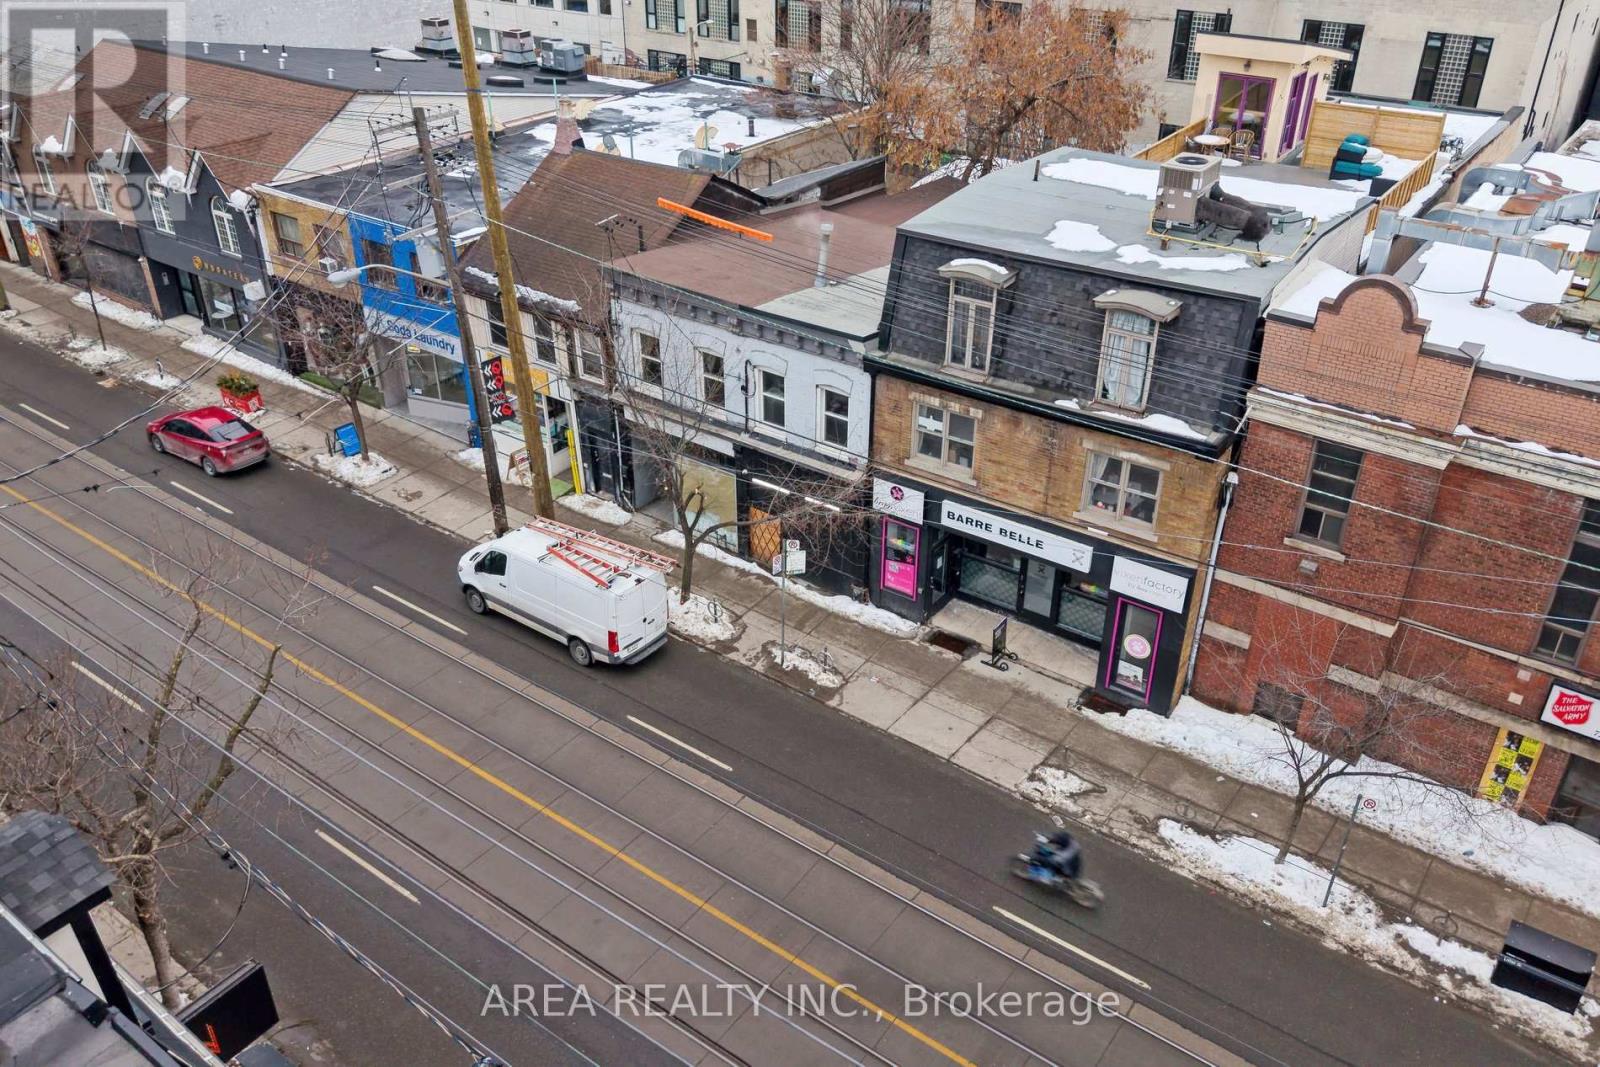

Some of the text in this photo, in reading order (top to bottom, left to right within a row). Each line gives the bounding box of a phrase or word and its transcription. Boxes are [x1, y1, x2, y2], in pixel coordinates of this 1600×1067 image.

[386, 319, 455, 355] Soda Laundry
[946, 510, 1044, 550] BARRE BELLE
[1552, 703, 1590, 713] SALVATION
[1561, 712, 1587, 721] ARMY
